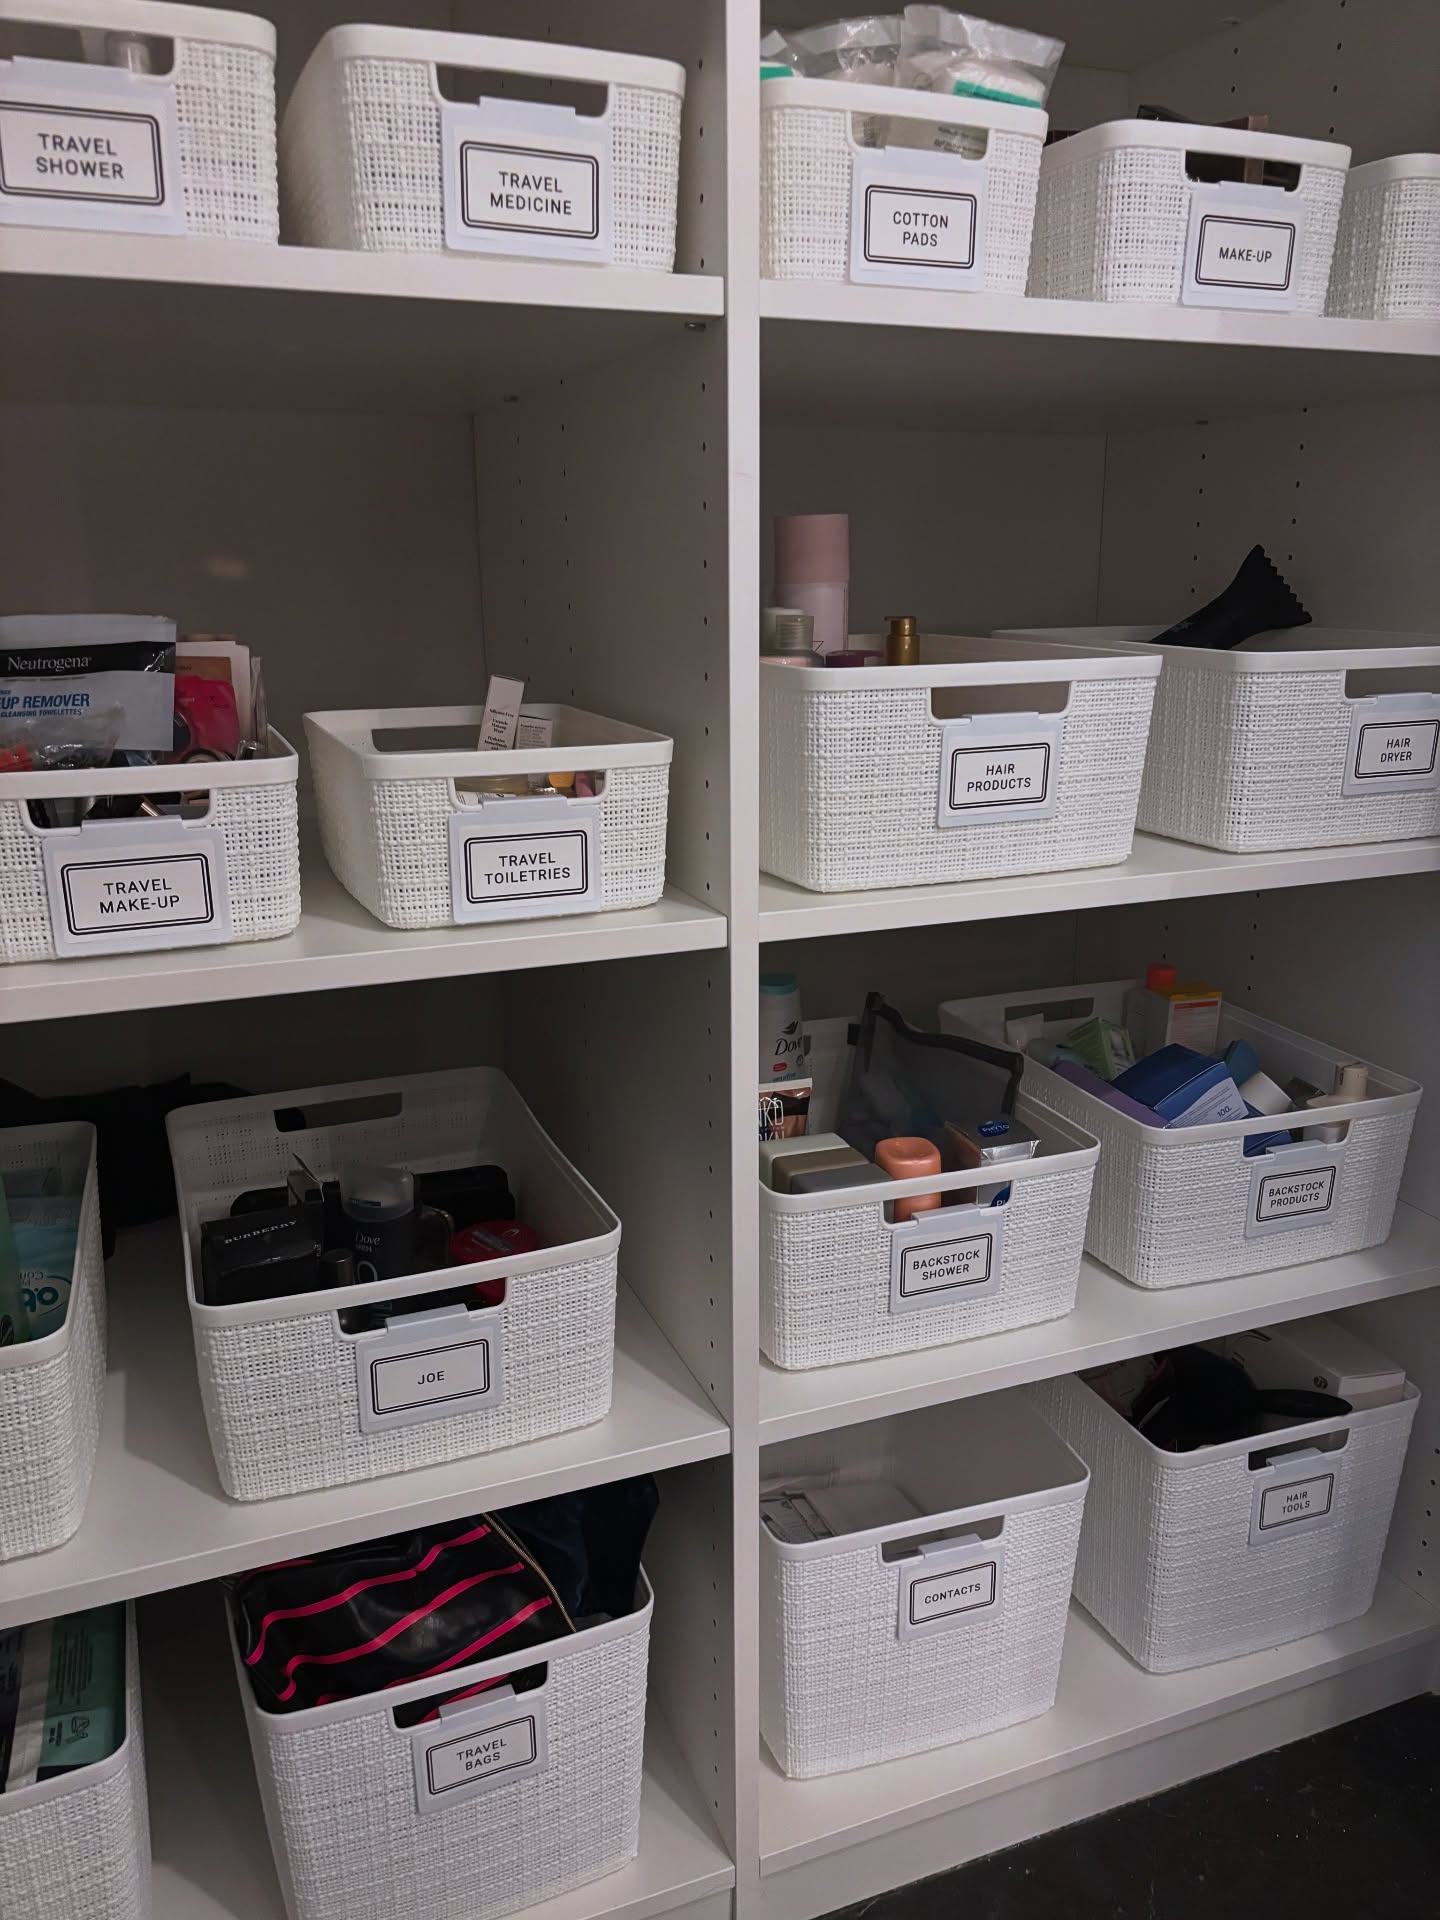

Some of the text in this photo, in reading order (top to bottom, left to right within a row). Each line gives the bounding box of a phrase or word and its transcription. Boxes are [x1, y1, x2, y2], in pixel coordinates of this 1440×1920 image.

[37, 132, 117, 156] TRAVEL
[35, 156, 124, 179] SHOWER
[498, 171, 563, 193] TRAVEL
[490, 192, 572, 215] MEDICINE
[892, 211, 949, 229] COTTON
[902, 231, 938, 247] PADS
[1218, 246, 1273, 263] MAKE-UP
[7, 655, 90, 672] Neutrogena
[0, 693, 90, 710] UP REMOVER
[1386, 737, 1411, 749] HAIR
[1380, 750, 1413, 763] DRYER
[986, 763, 1015, 776] HAIR
[967, 777, 1032, 793] PRODUCTS
[498, 852, 556, 868] TRAVEL
[484, 866, 571, 885] TOILETRIES
[103, 878, 172, 896] TRAVEL
[99, 895, 180, 914] MAKE-UP
[1268, 1180, 1325, 1197] BACKSTOCK
[1270, 1192, 1320, 1209] PRODUCTS
[912, 1249, 980, 1271] BACKSTOCK
[921, 1263, 970, 1281] SHOWER
[417, 1370, 445, 1385] JOE
[1286, 1491, 1308, 1503] HAIR
[1282, 1500, 1311, 1514] TOOLS
[924, 1583, 981, 1604] CONTACTS
[456, 1738, 507, 1761] TRAVEL
[465, 1751, 501, 1771] BAGS
